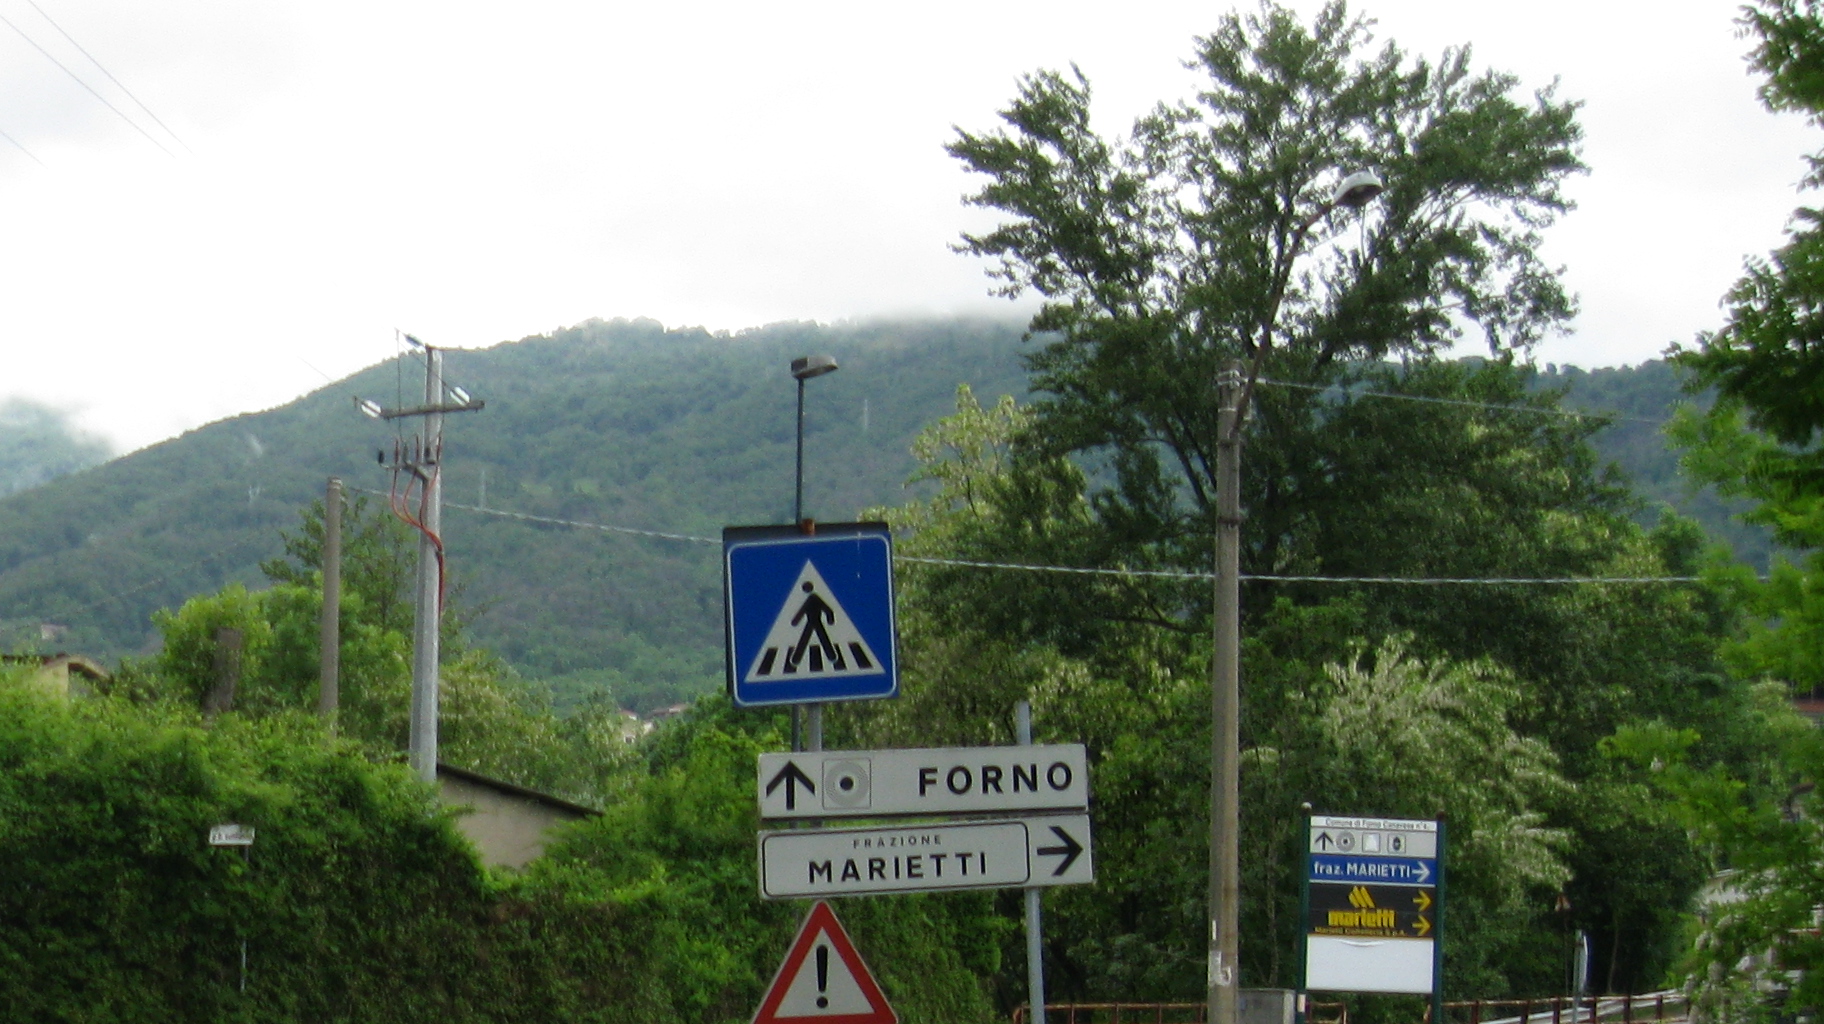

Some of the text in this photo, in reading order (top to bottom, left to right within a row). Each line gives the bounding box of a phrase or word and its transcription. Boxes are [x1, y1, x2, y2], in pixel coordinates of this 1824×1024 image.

[918, 761, 1074, 797] FORNO
[852, 834, 943, 849] FRAZIONE
[807, 851, 988, 884] MARIETTI
[1314, 861, 1410, 879] fraz. MARIETTI
[1328, 908, 1395, 928] marietti
